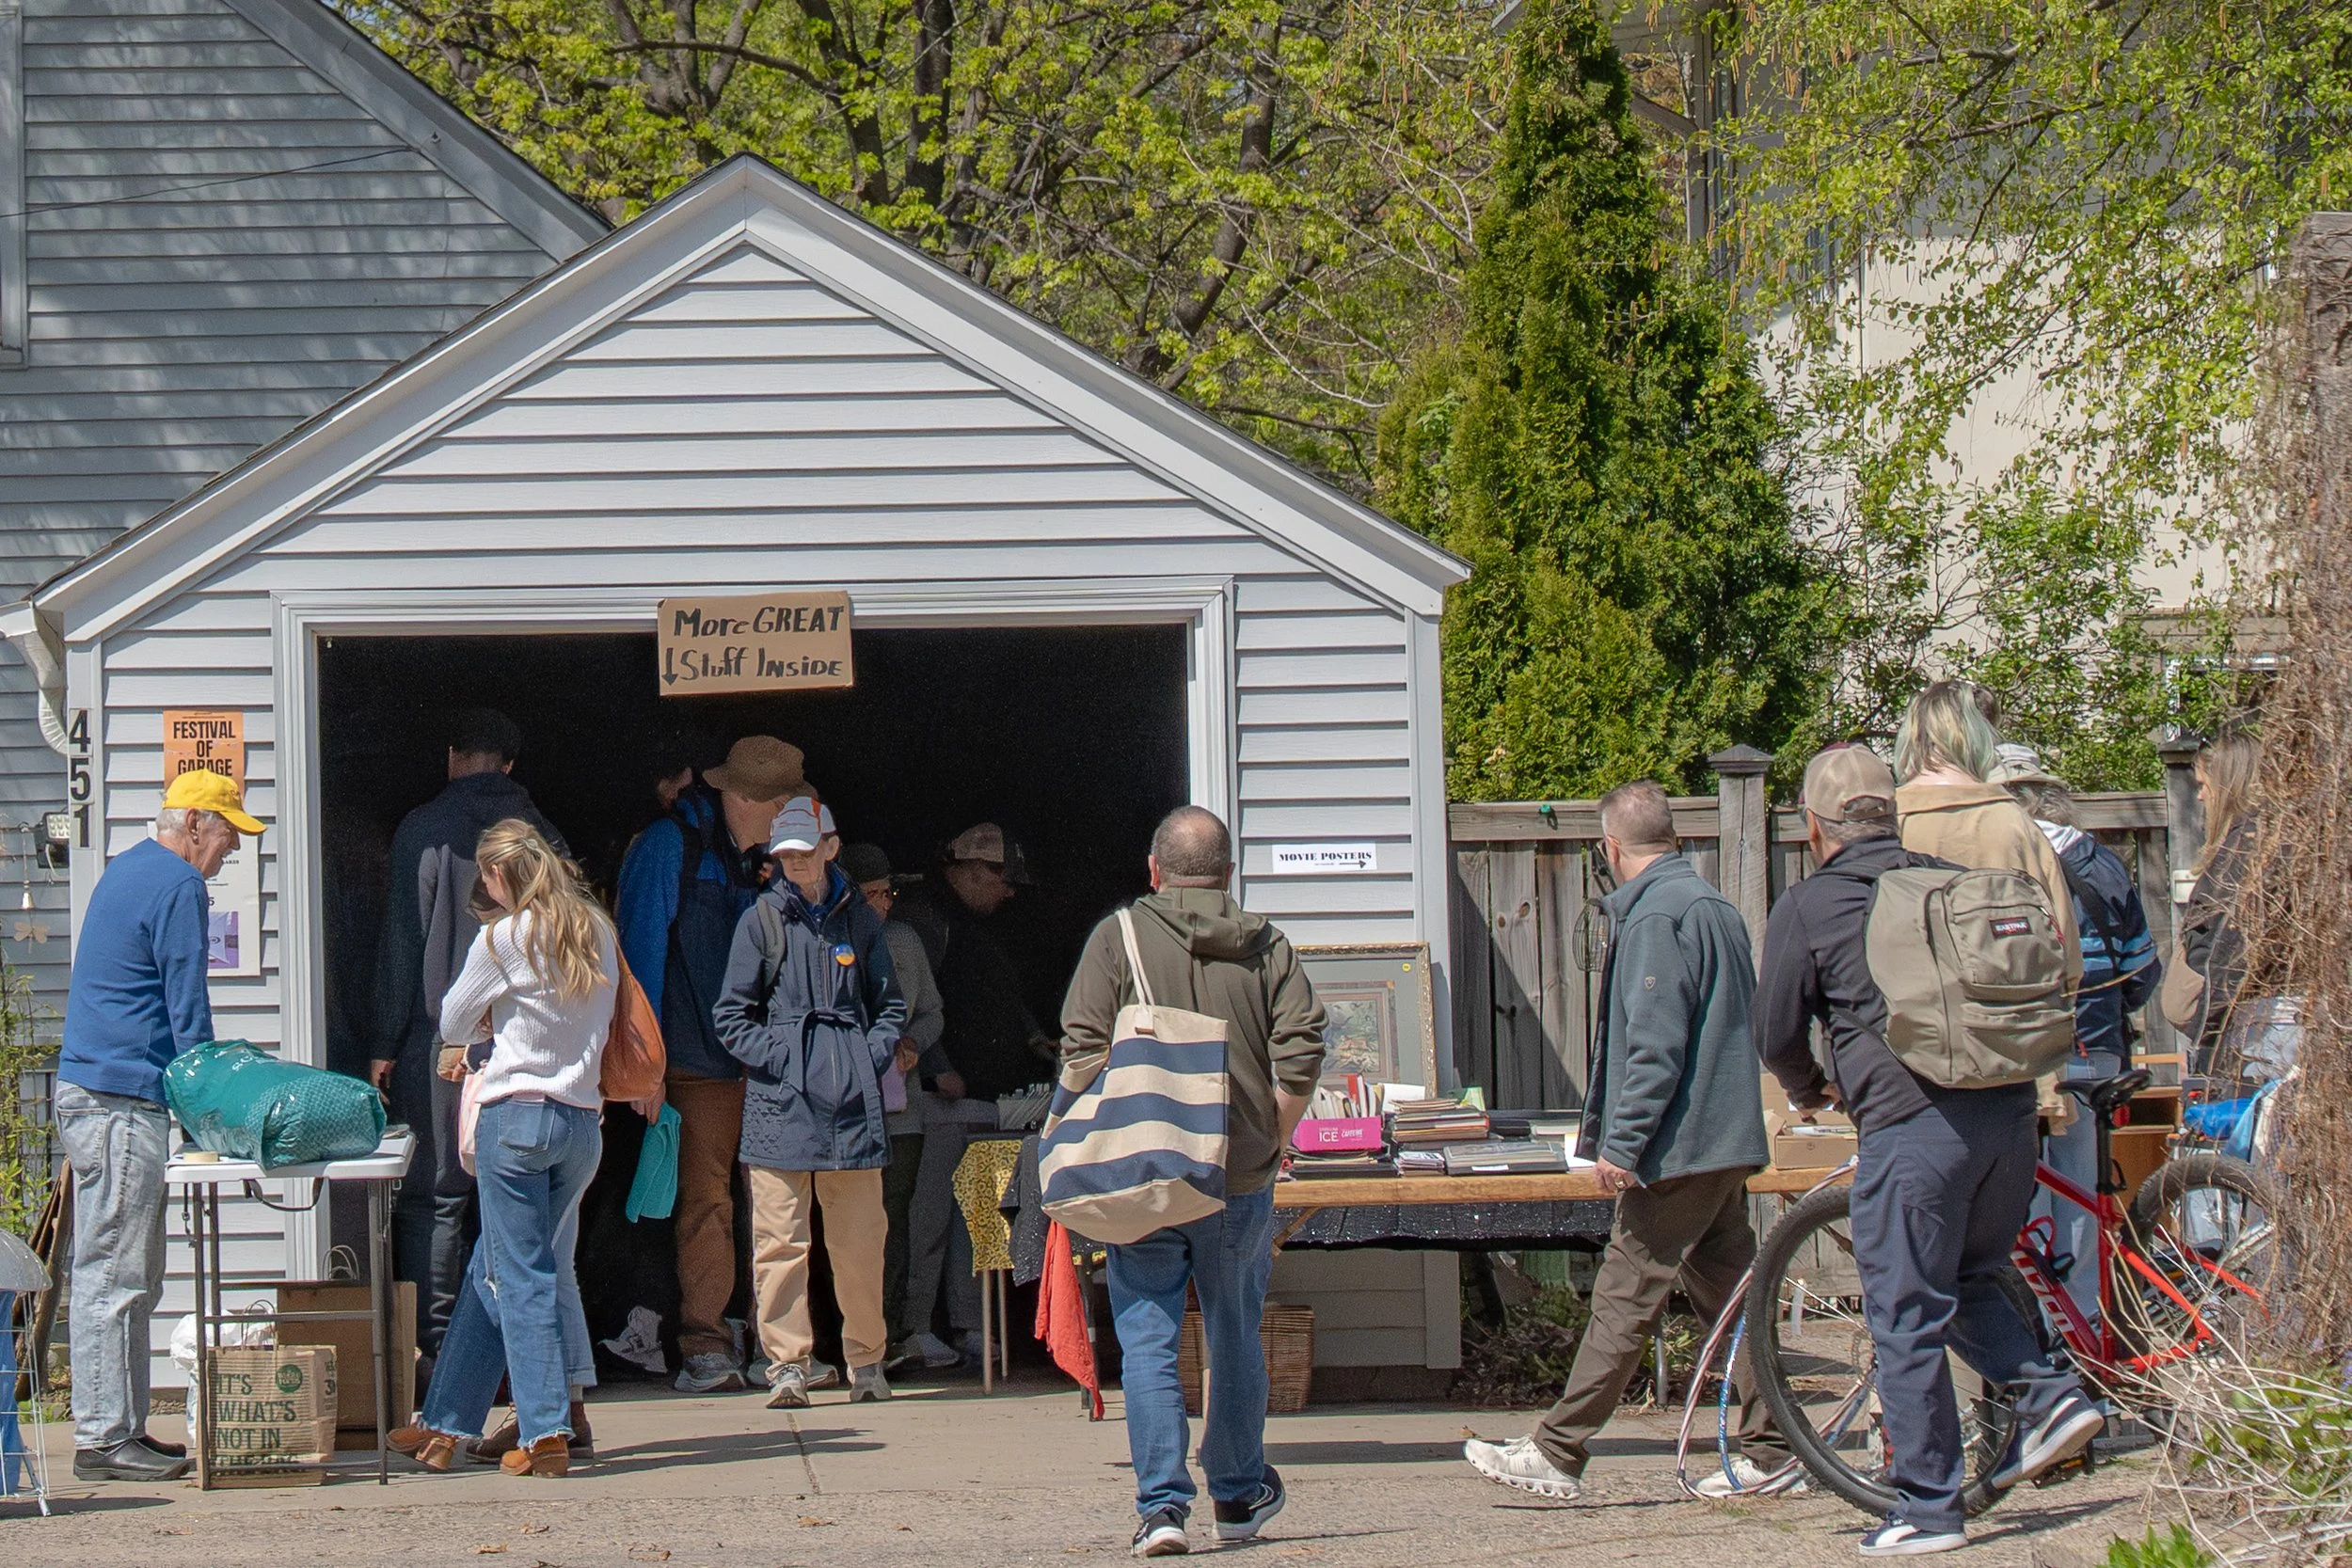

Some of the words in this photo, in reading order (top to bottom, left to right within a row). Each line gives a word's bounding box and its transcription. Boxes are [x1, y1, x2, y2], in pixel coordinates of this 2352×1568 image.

[674, 608, 750, 638] More
[753, 605, 844, 634] GREAT
[680, 646, 749, 680] Stuff
[173, 721, 236, 739] FESTIVAL
[197, 740, 213, 757] OF
[178, 758, 232, 776] GARAGE
[1279, 853, 1317, 862] MOVIE
[1321, 851, 1372, 861] POSTERS
[1319, 1132, 1339, 1142] ICE
[217, 1374, 252, 1395] IT'S
[217, 1401, 296, 1422] WHAT'S
[216, 1428, 255, 1449] NOT
[262, 1428, 280, 1449] IN
